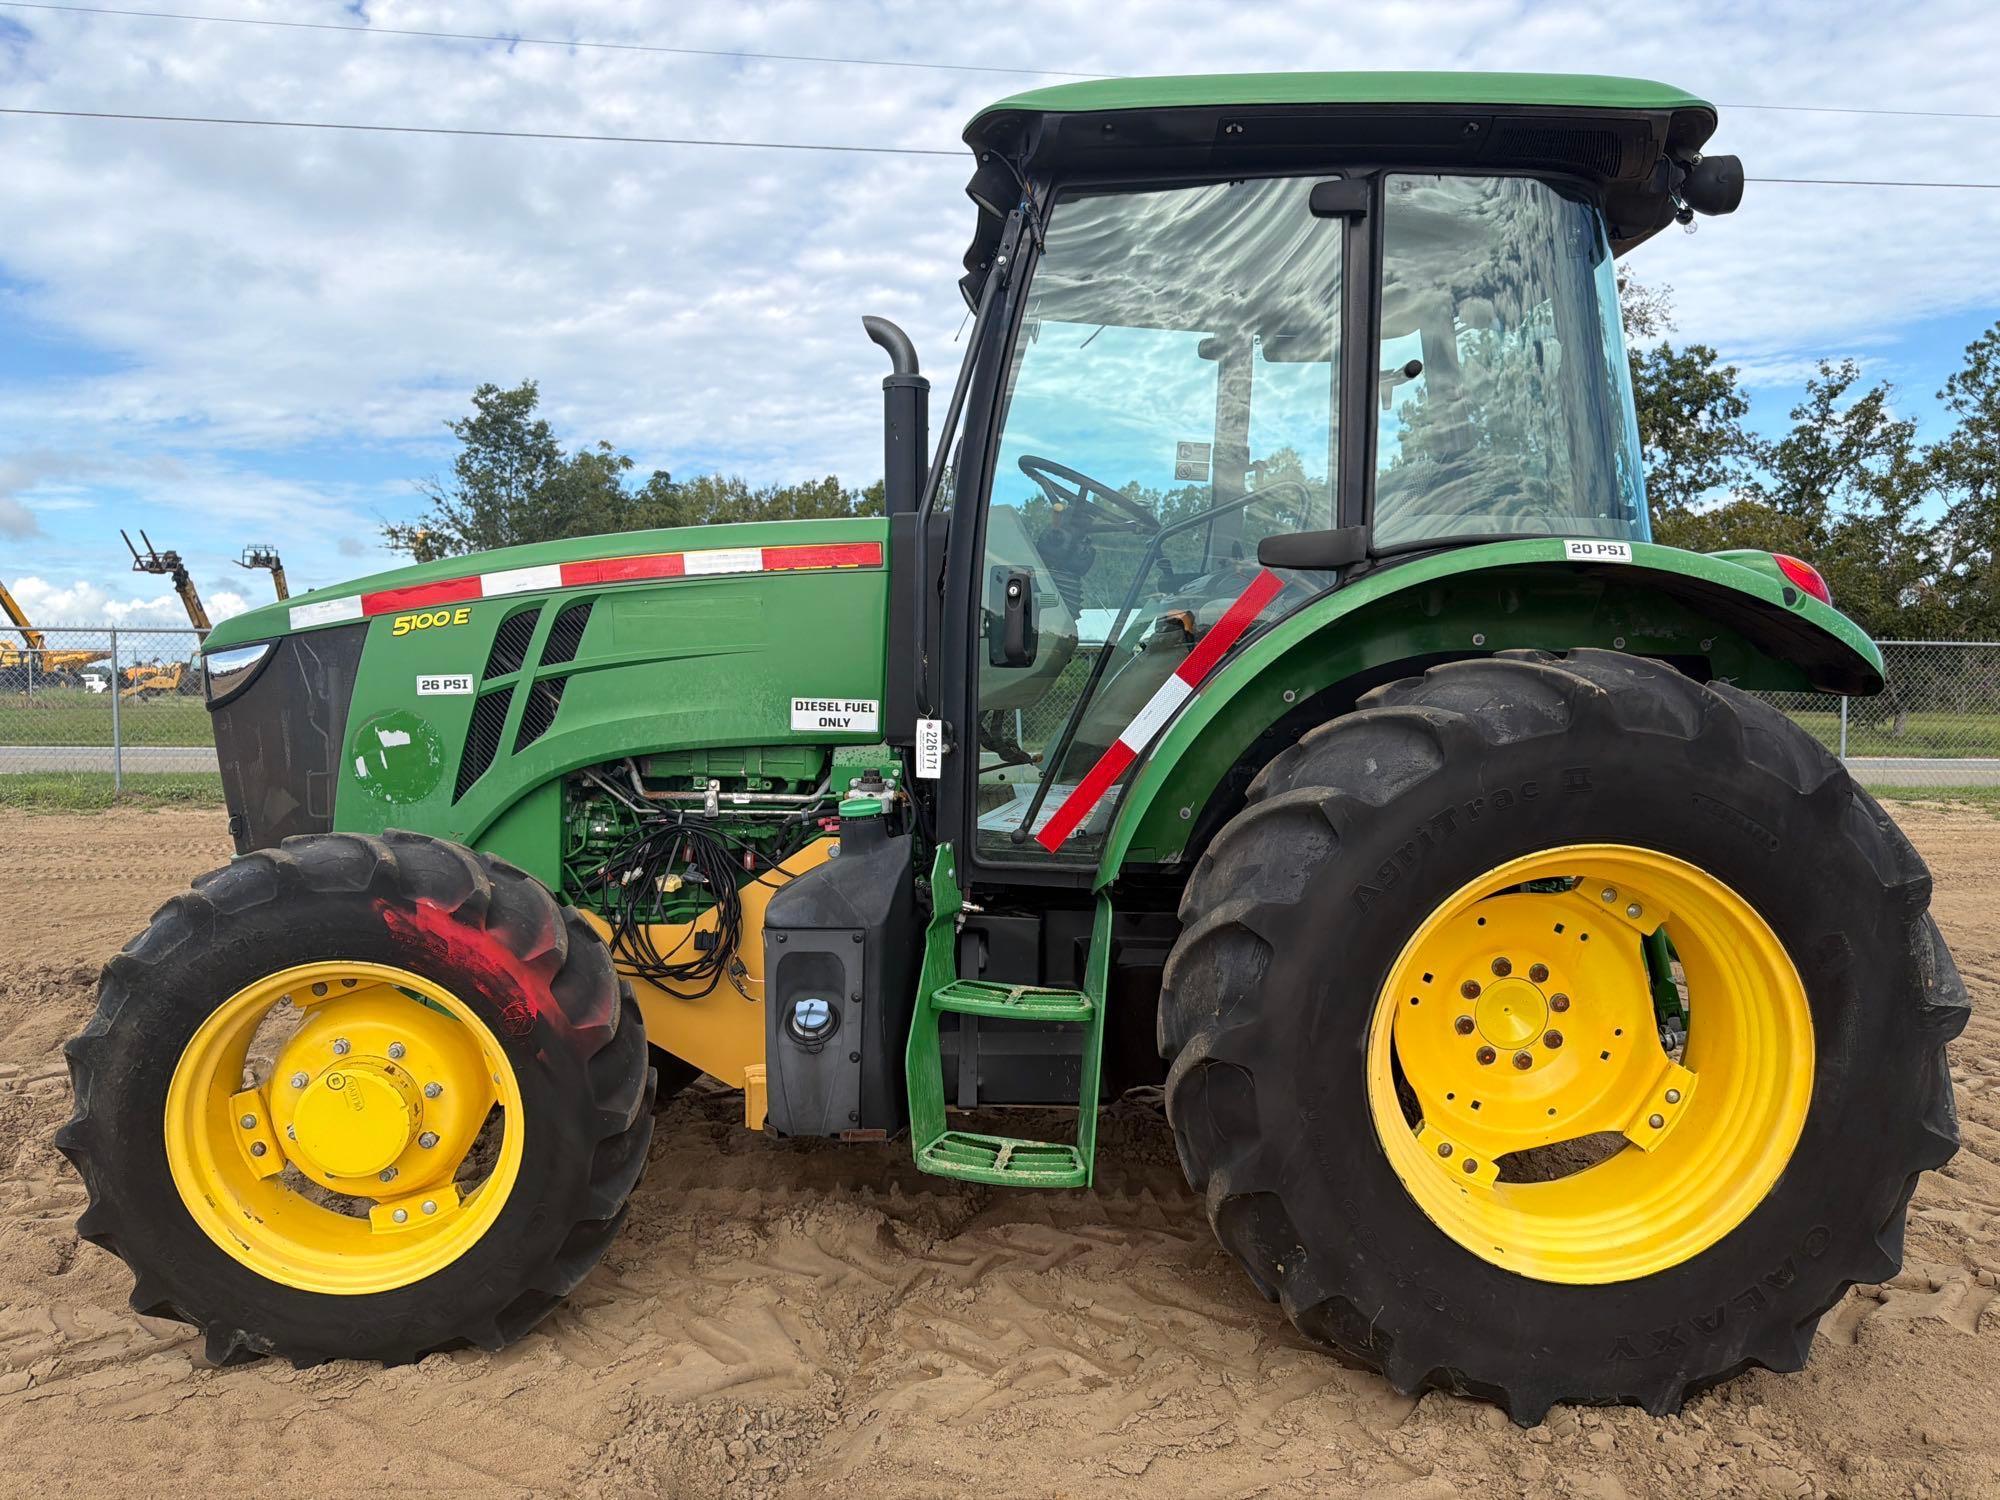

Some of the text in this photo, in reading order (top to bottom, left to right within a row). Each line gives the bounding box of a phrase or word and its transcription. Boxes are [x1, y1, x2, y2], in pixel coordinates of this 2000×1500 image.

[1571, 543, 1627, 556] 20 PSI
[421, 678, 469, 691] 26 PSI
[795, 701, 875, 713] DIESEL FUEL
[819, 717, 851, 728] ONLY
[926, 732, 938, 770] 226171
[1605, 1225, 1832, 1361] GALAXY
